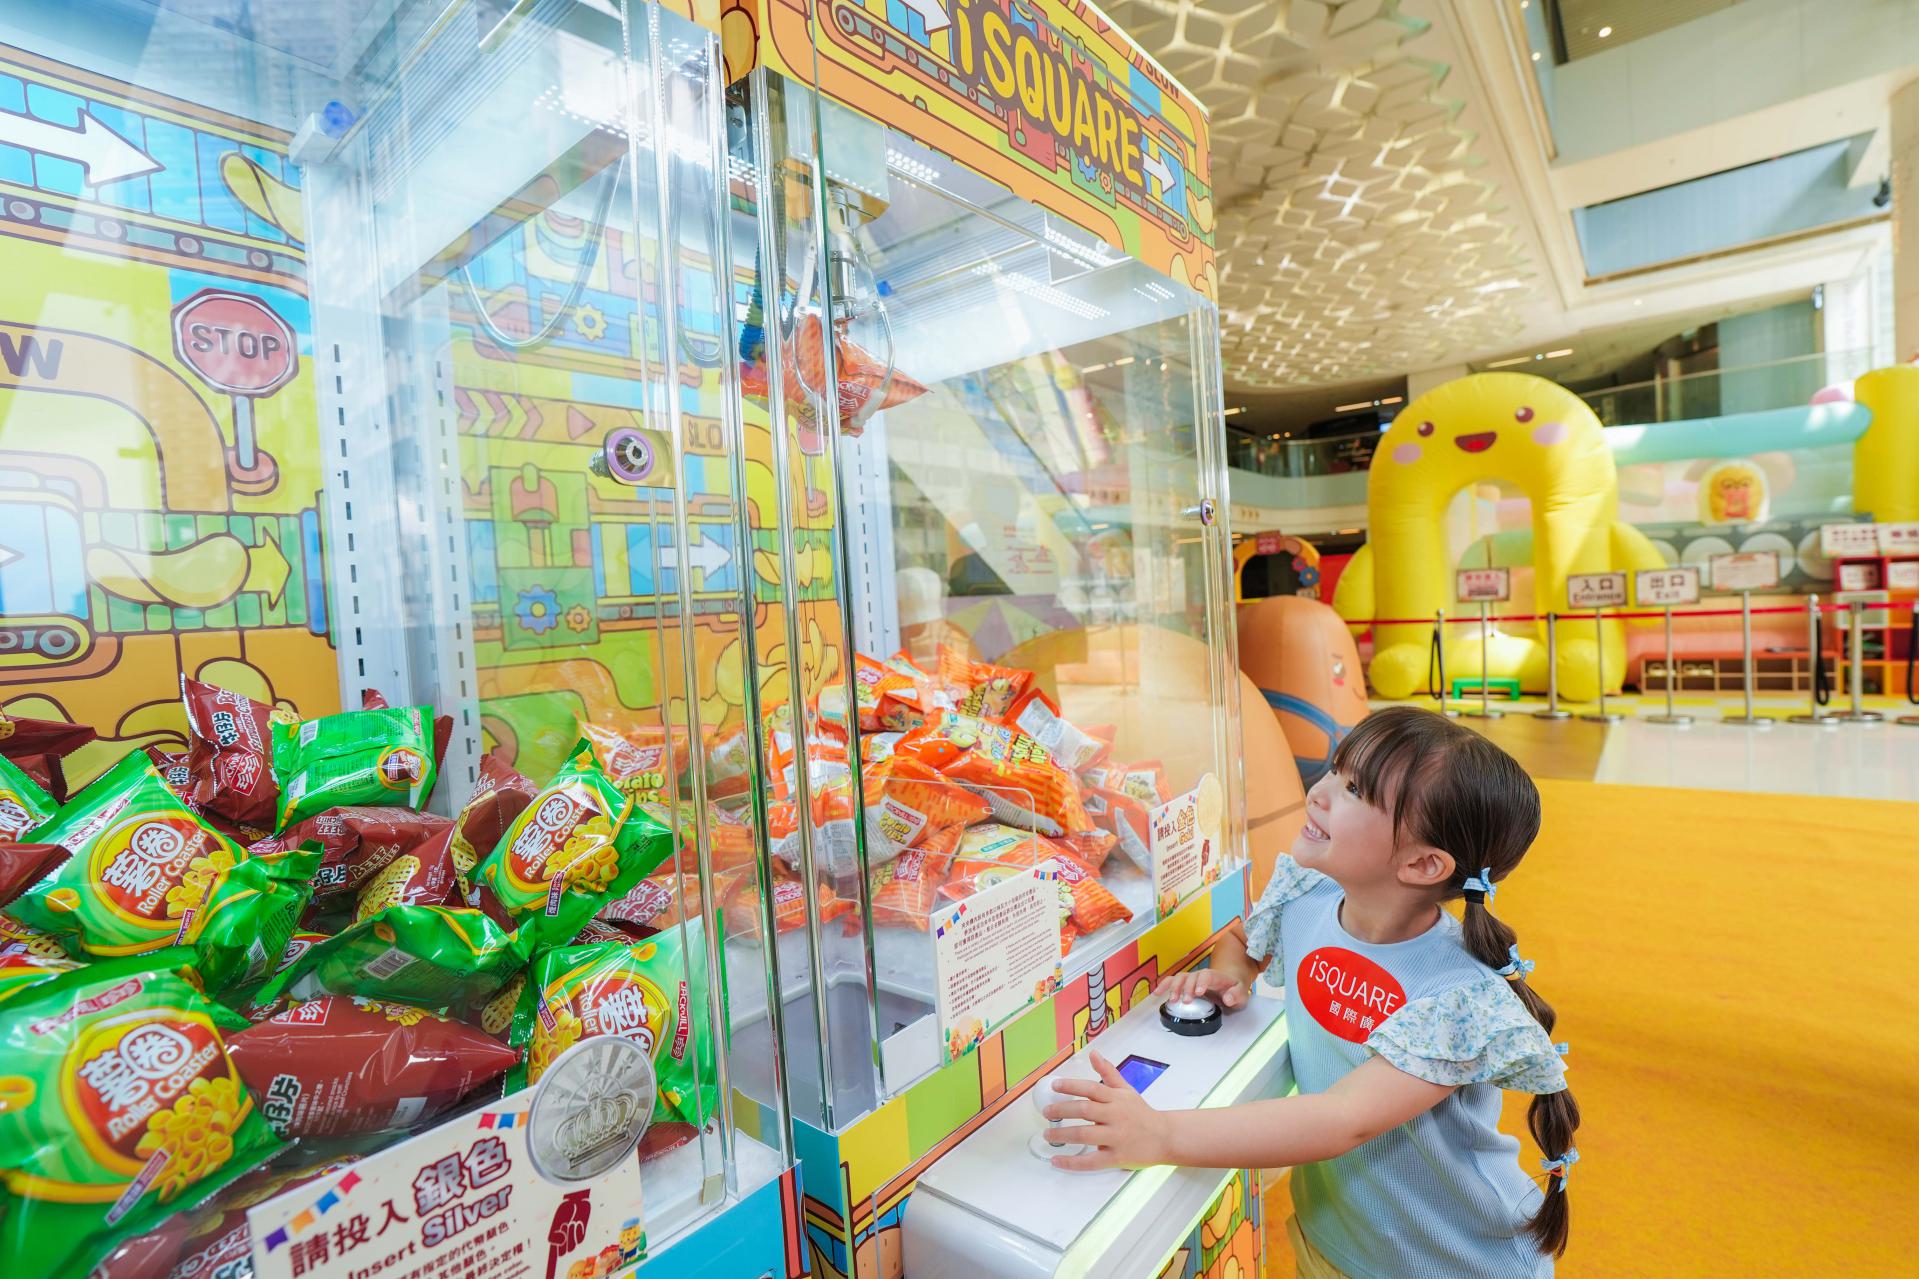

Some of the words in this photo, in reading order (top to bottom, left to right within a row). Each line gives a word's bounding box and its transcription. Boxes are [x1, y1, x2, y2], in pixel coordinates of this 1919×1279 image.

[190, 321, 282, 362] STOP
[1582, 577, 1613, 592] 入口
[1650, 575, 1685, 588] 出口
[136, 876, 170, 916] Roller
[164, 826, 209, 878] Coaster
[524, 844, 556, 880] Roller
[1308, 954, 1399, 1017] iSQUARE
[106, 1096, 159, 1143] Roller
[154, 1040, 221, 1099] Coaster
[289, 1136, 512, 1279] 請投入銀色
[422, 1184, 513, 1249] Silver
